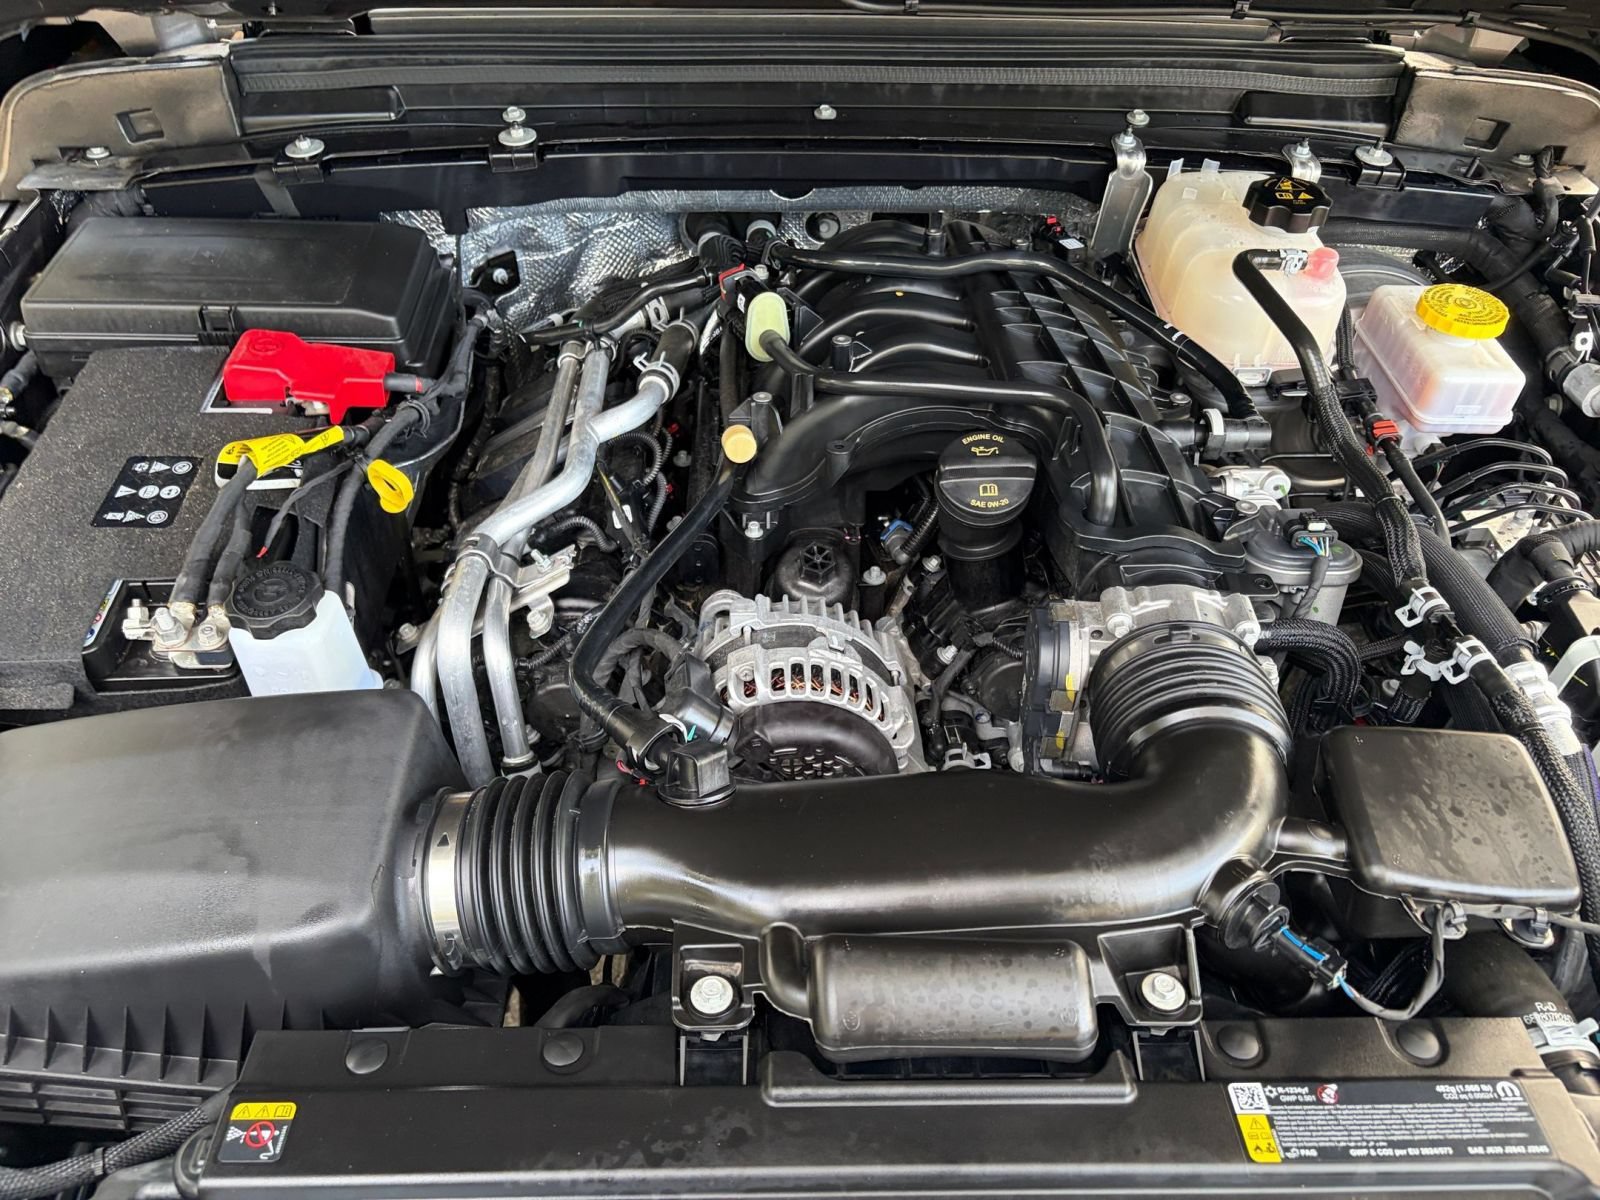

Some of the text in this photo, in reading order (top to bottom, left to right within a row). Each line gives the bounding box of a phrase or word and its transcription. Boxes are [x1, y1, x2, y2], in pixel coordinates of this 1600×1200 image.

[962, 433, 1005, 445] ENGINE OIL
[970, 498, 1009, 509] SAE 0W-20
[1349, 1148, 1368, 1157] GWP
